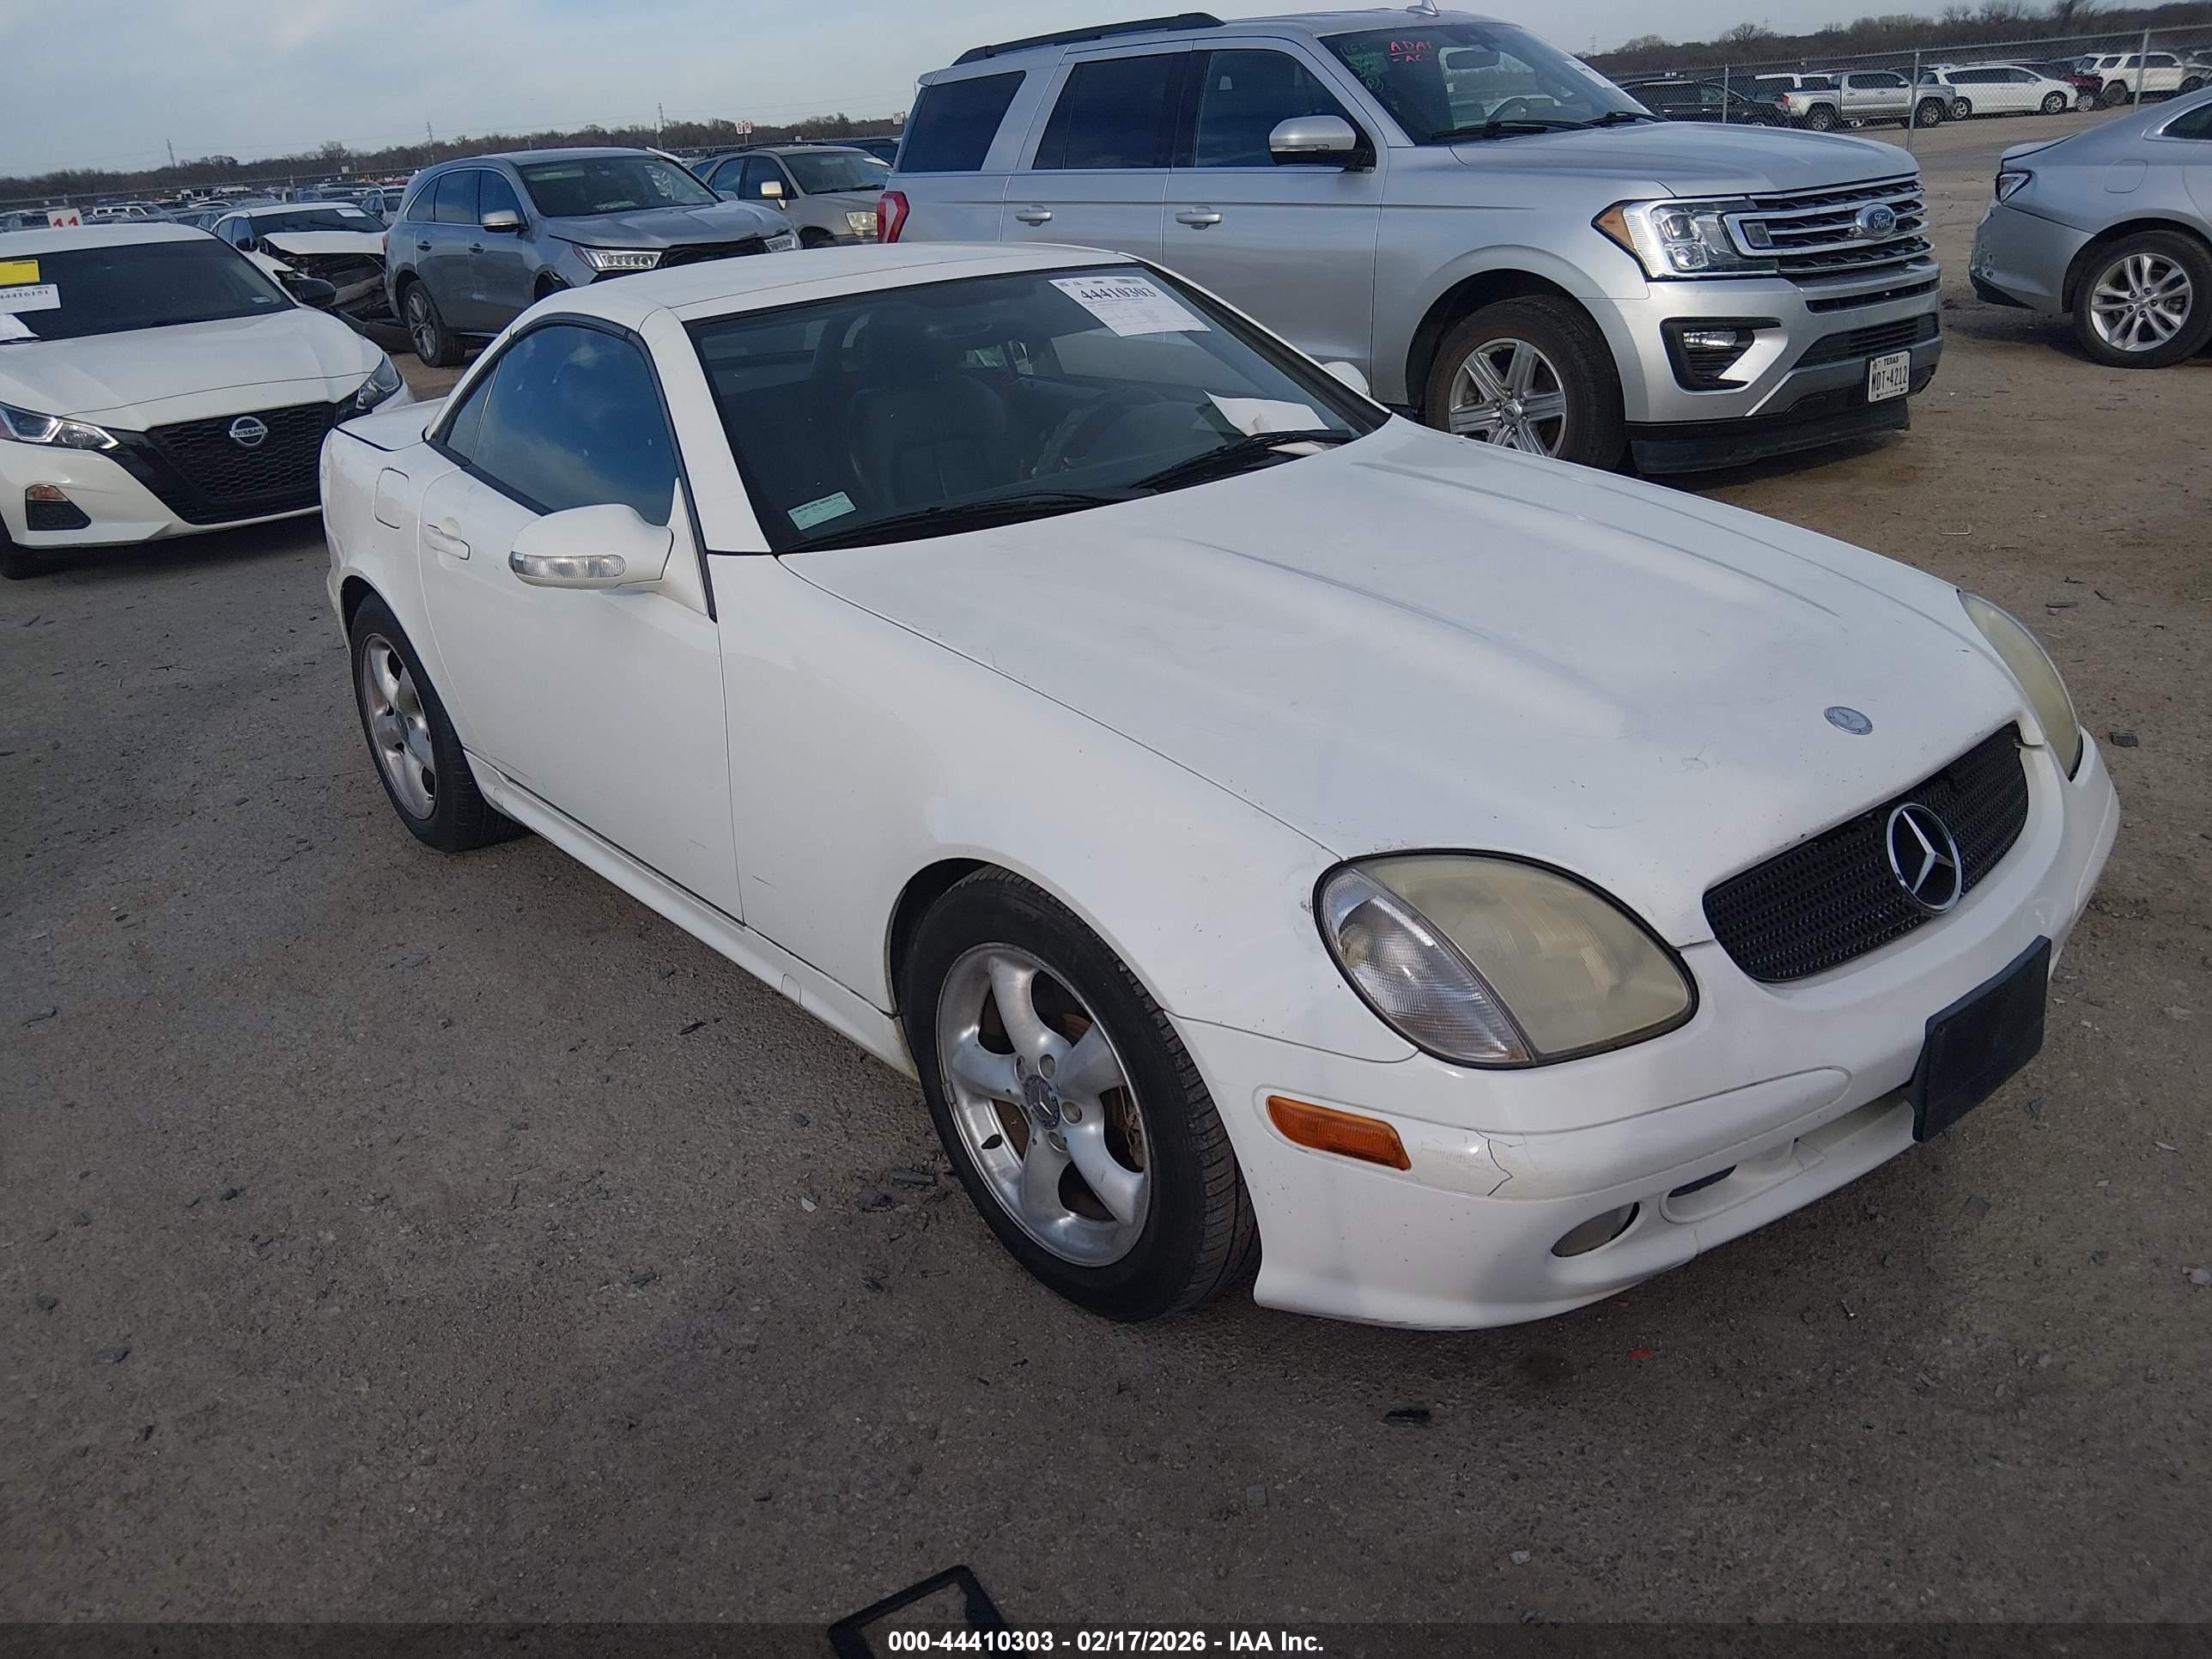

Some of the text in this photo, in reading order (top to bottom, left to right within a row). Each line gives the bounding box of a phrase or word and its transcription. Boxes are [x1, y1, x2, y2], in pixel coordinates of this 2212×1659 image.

[1874, 212, 1891, 229] Ford
[1080, 287, 1157, 301] 44410303
[1883, 355, 1899, 366] TEXAS
[234, 428, 264, 437] NISSAN
